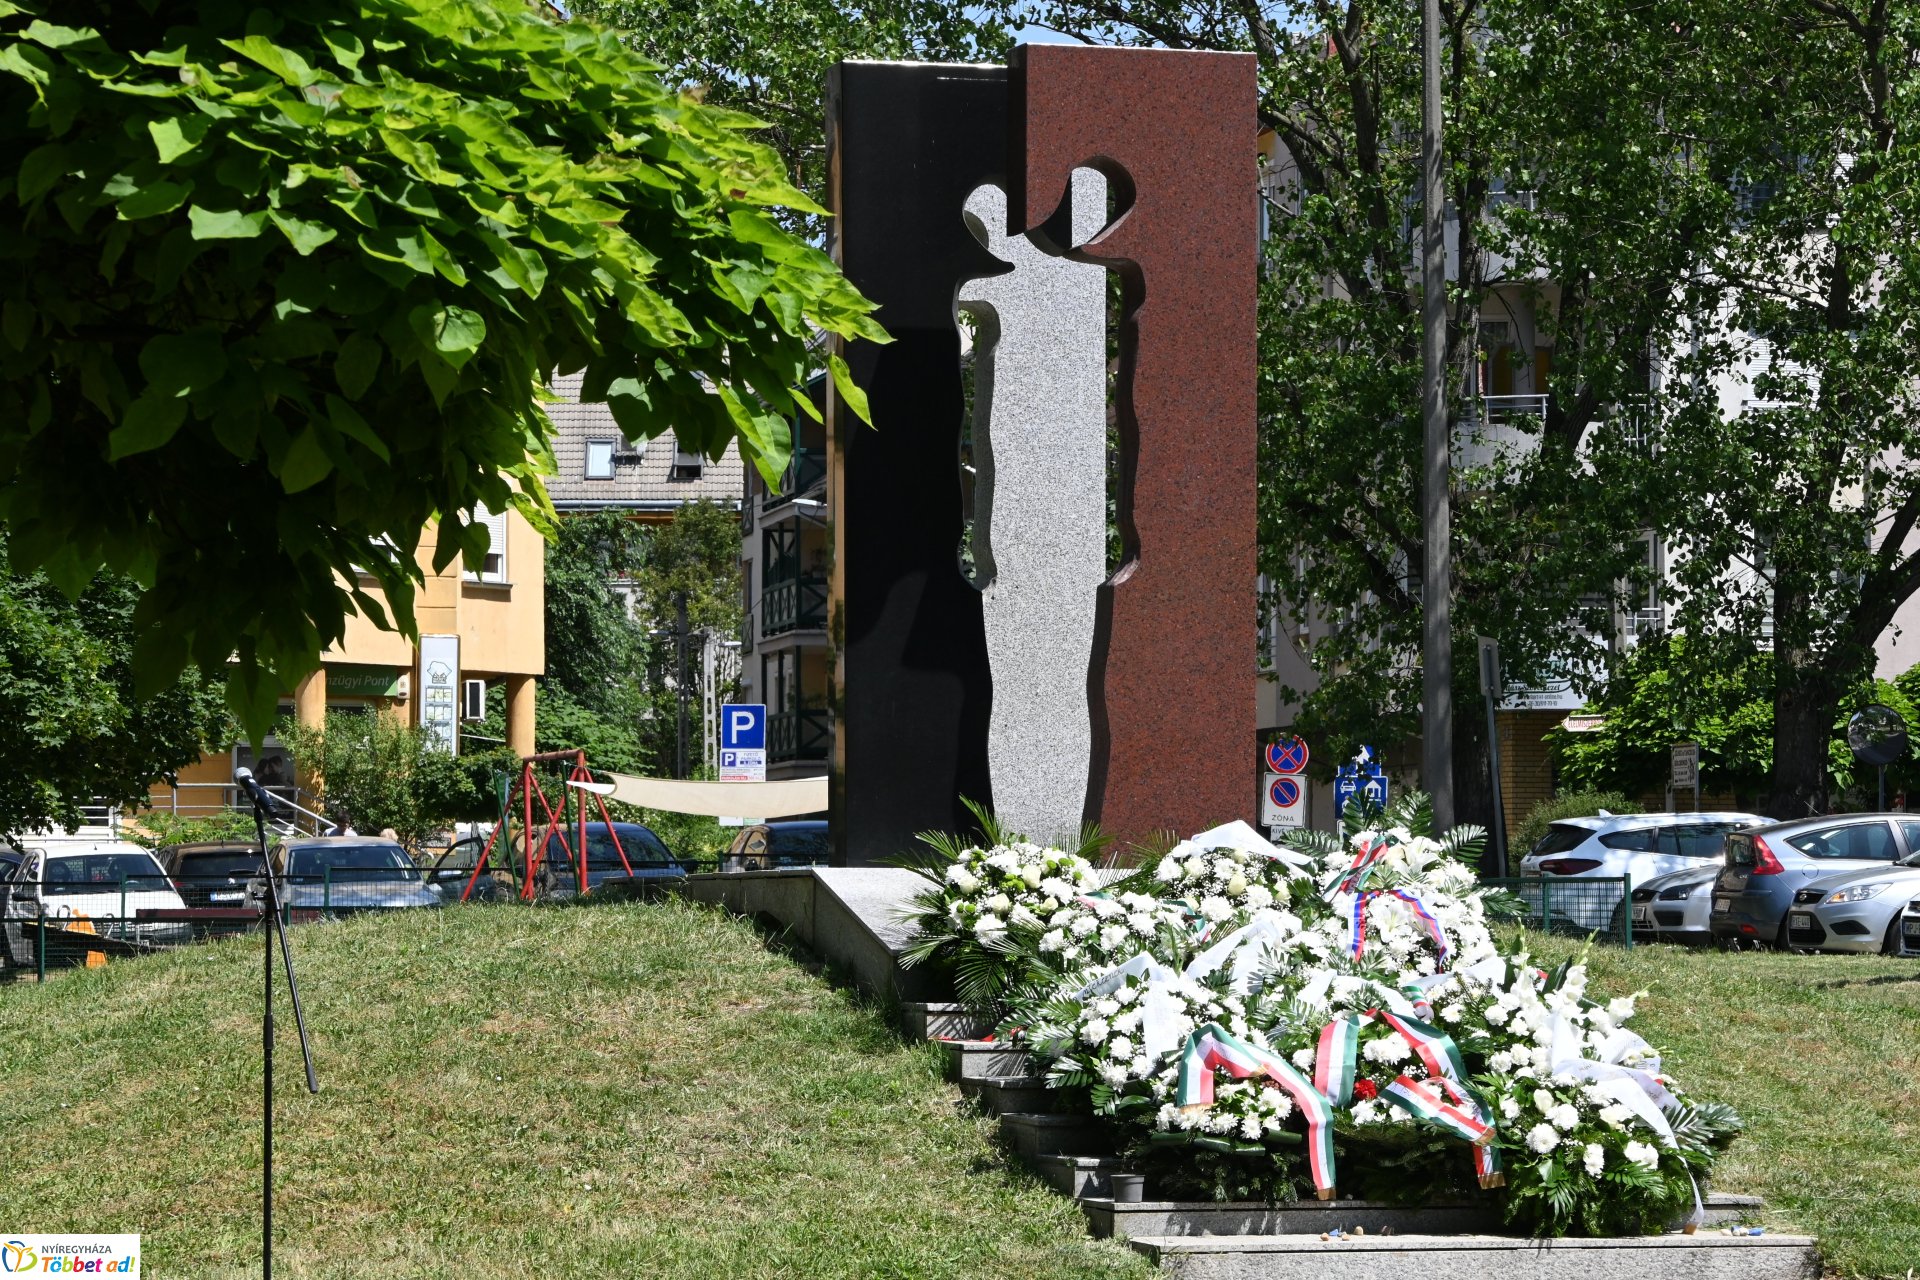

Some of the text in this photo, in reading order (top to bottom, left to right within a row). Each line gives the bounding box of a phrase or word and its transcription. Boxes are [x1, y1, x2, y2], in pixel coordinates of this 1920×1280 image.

[327, 674, 390, 689] nzügyi Pont
[732, 711, 755, 743] P
[725, 754, 734, 765] P
